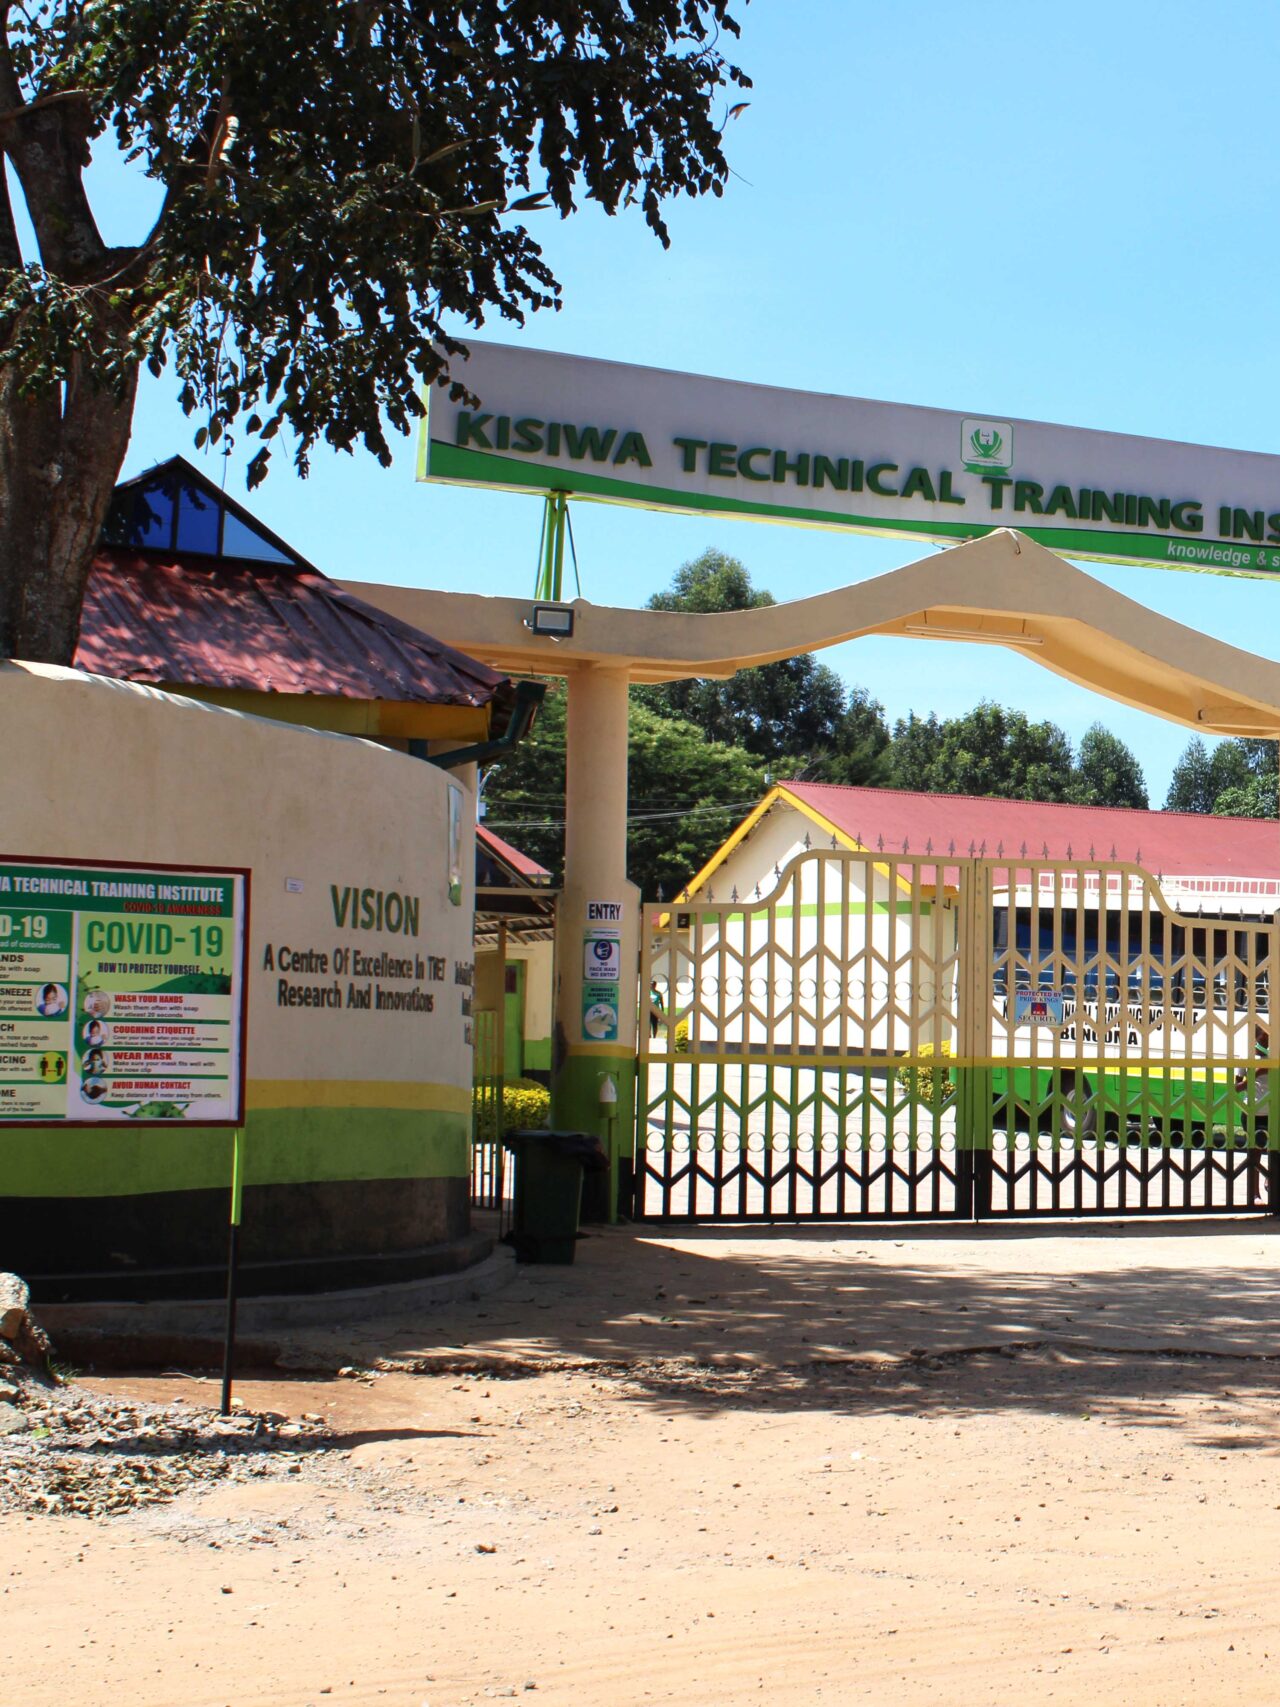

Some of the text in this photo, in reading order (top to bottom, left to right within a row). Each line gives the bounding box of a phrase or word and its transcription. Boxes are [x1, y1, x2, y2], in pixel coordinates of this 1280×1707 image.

[456, 411, 653, 468] KISIWA
[673, 437, 966, 505] TECHNICAL
[982, 476, 1203, 532] TRAINING
[1167, 541, 1250, 567] knowledge
[1257, 553, 1267, 566] &
[13, 876, 89, 896] TECHNICAL
[91, 881, 155, 899] TRAINING
[158, 885, 223, 902] INSTITUTE
[124, 901, 221, 915] COVID-19 AWARENESS
[330, 885, 420, 937] VISION
[589, 903, 621, 920] ENTRY
[87, 920, 223, 957] COVID-19
[97, 962, 201, 975] HOW TO PROTECT YOURSELF
[264, 943, 274, 971] A
[278, 946, 328, 974] Centre
[333, 948, 349, 975] Of
[353, 950, 412, 979] Excellence
[415, 953, 424, 980] In
[0, 988, 32, 996] SNEEZE
[114, 994, 136, 1002] WASH
[138, 995, 157, 1003] YOUR
[277, 979, 342, 1008] Research
[346, 983, 371, 1010] And
[113, 1026, 196, 1034] COUGHING ETIQUETTE
[113, 1052, 173, 1060] WEAR MASK
[112, 1081, 133, 1089] AVOID
